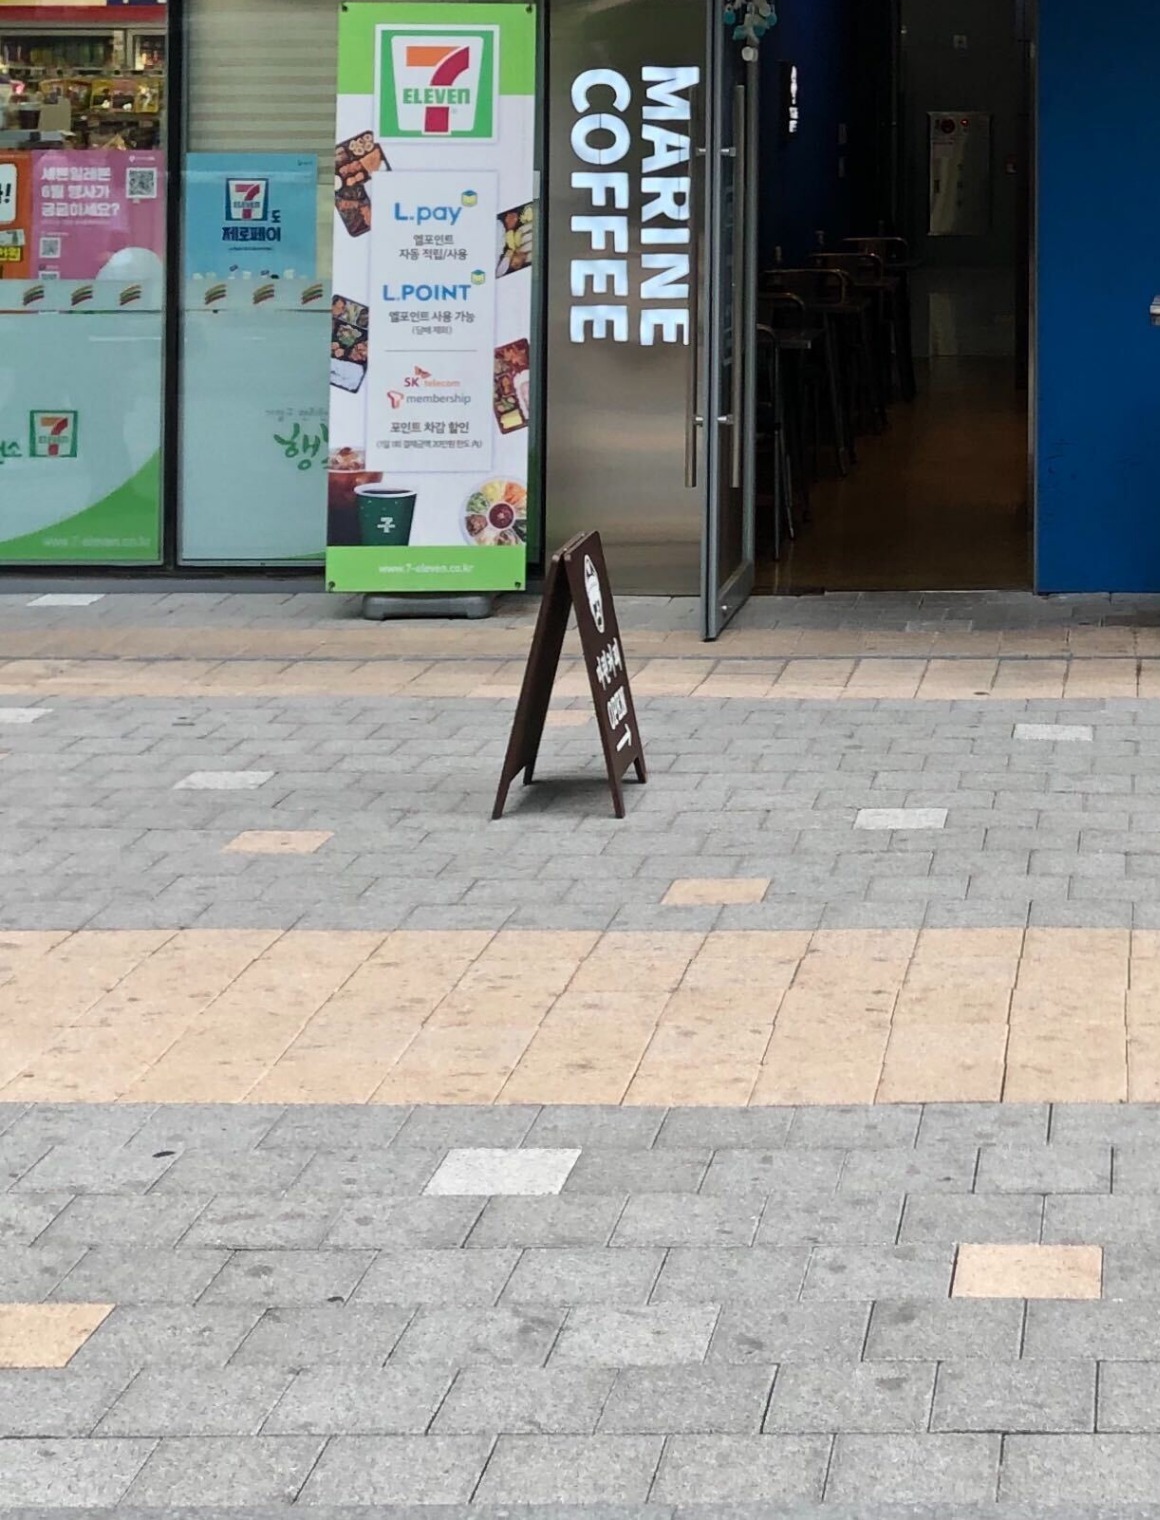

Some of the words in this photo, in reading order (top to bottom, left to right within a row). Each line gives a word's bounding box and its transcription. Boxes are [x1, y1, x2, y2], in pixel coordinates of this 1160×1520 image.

[570, 68, 632, 343] COFFEE
[640, 66, 700, 346] MARINE
[394, 202, 462, 226] L.pay
[221, 226, 281, 242] 제로페이
[399, 249, 419, 260] 자동
[382, 284, 472, 301] L.POINT
[431, 311, 452, 323] 사용
[454, 311, 475, 323] 가능
[404, 378, 420, 388] SK
[406, 392, 471, 405] membership
[389, 421, 422, 433] 포인트
[424, 421, 446, 433] 차감
[449, 421, 470, 433] 할인
